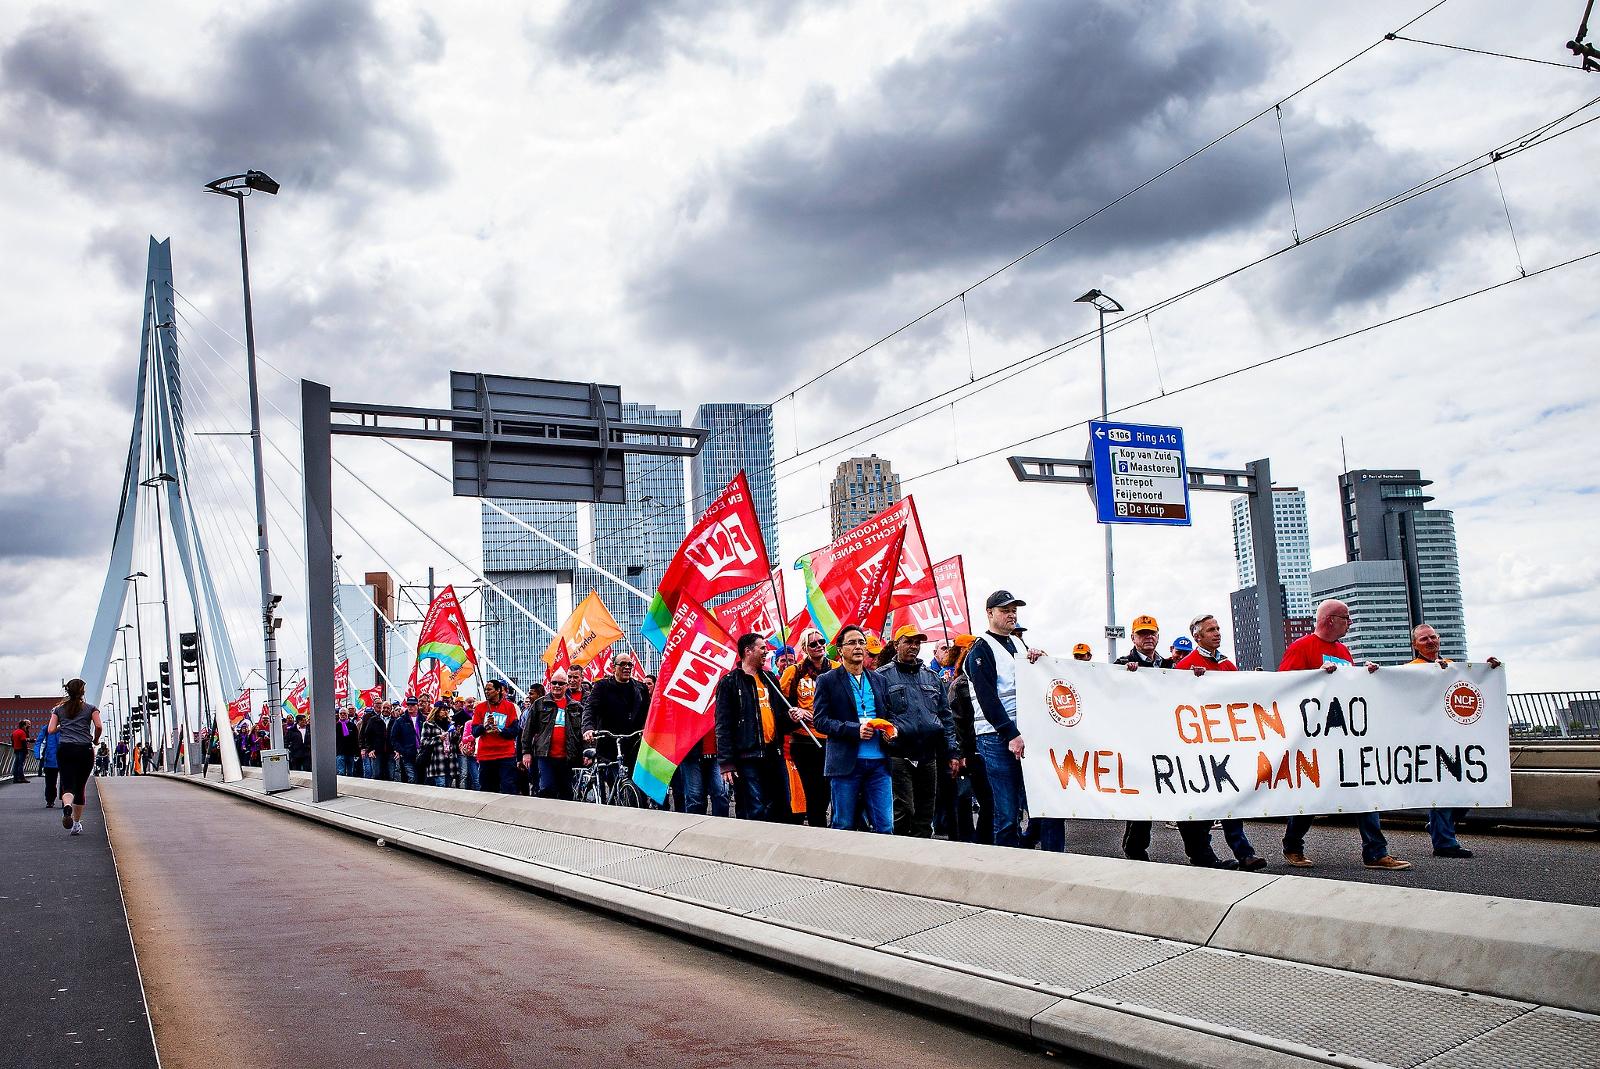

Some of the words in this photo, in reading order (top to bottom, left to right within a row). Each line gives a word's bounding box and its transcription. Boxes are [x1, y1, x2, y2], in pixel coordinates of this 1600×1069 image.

[1110, 431, 1115, 439] S
[1116, 432, 1129, 440] 106
[1136, 432, 1157, 445] Ring
[1120, 449, 1135, 460] Kop
[1154, 451, 1171, 460] Zuid
[1130, 462, 1176, 473] Maastoren
[1115, 476, 1154, 488] Entrepot
[1116, 489, 1163, 501] Feijenoord
[1129, 504, 1142, 514] De
[1144, 505, 1165, 517] Kuip
[1454, 695, 1475, 706] NCF
[1174, 701, 1286, 744] GEEN
[1299, 697, 1368, 737] CAO
[1049, 748, 1140, 795] WEL
[1152, 755, 1240, 794] RIJK
[1254, 748, 1320, 790] AAN
[1338, 745, 1488, 788] LEUGENS
